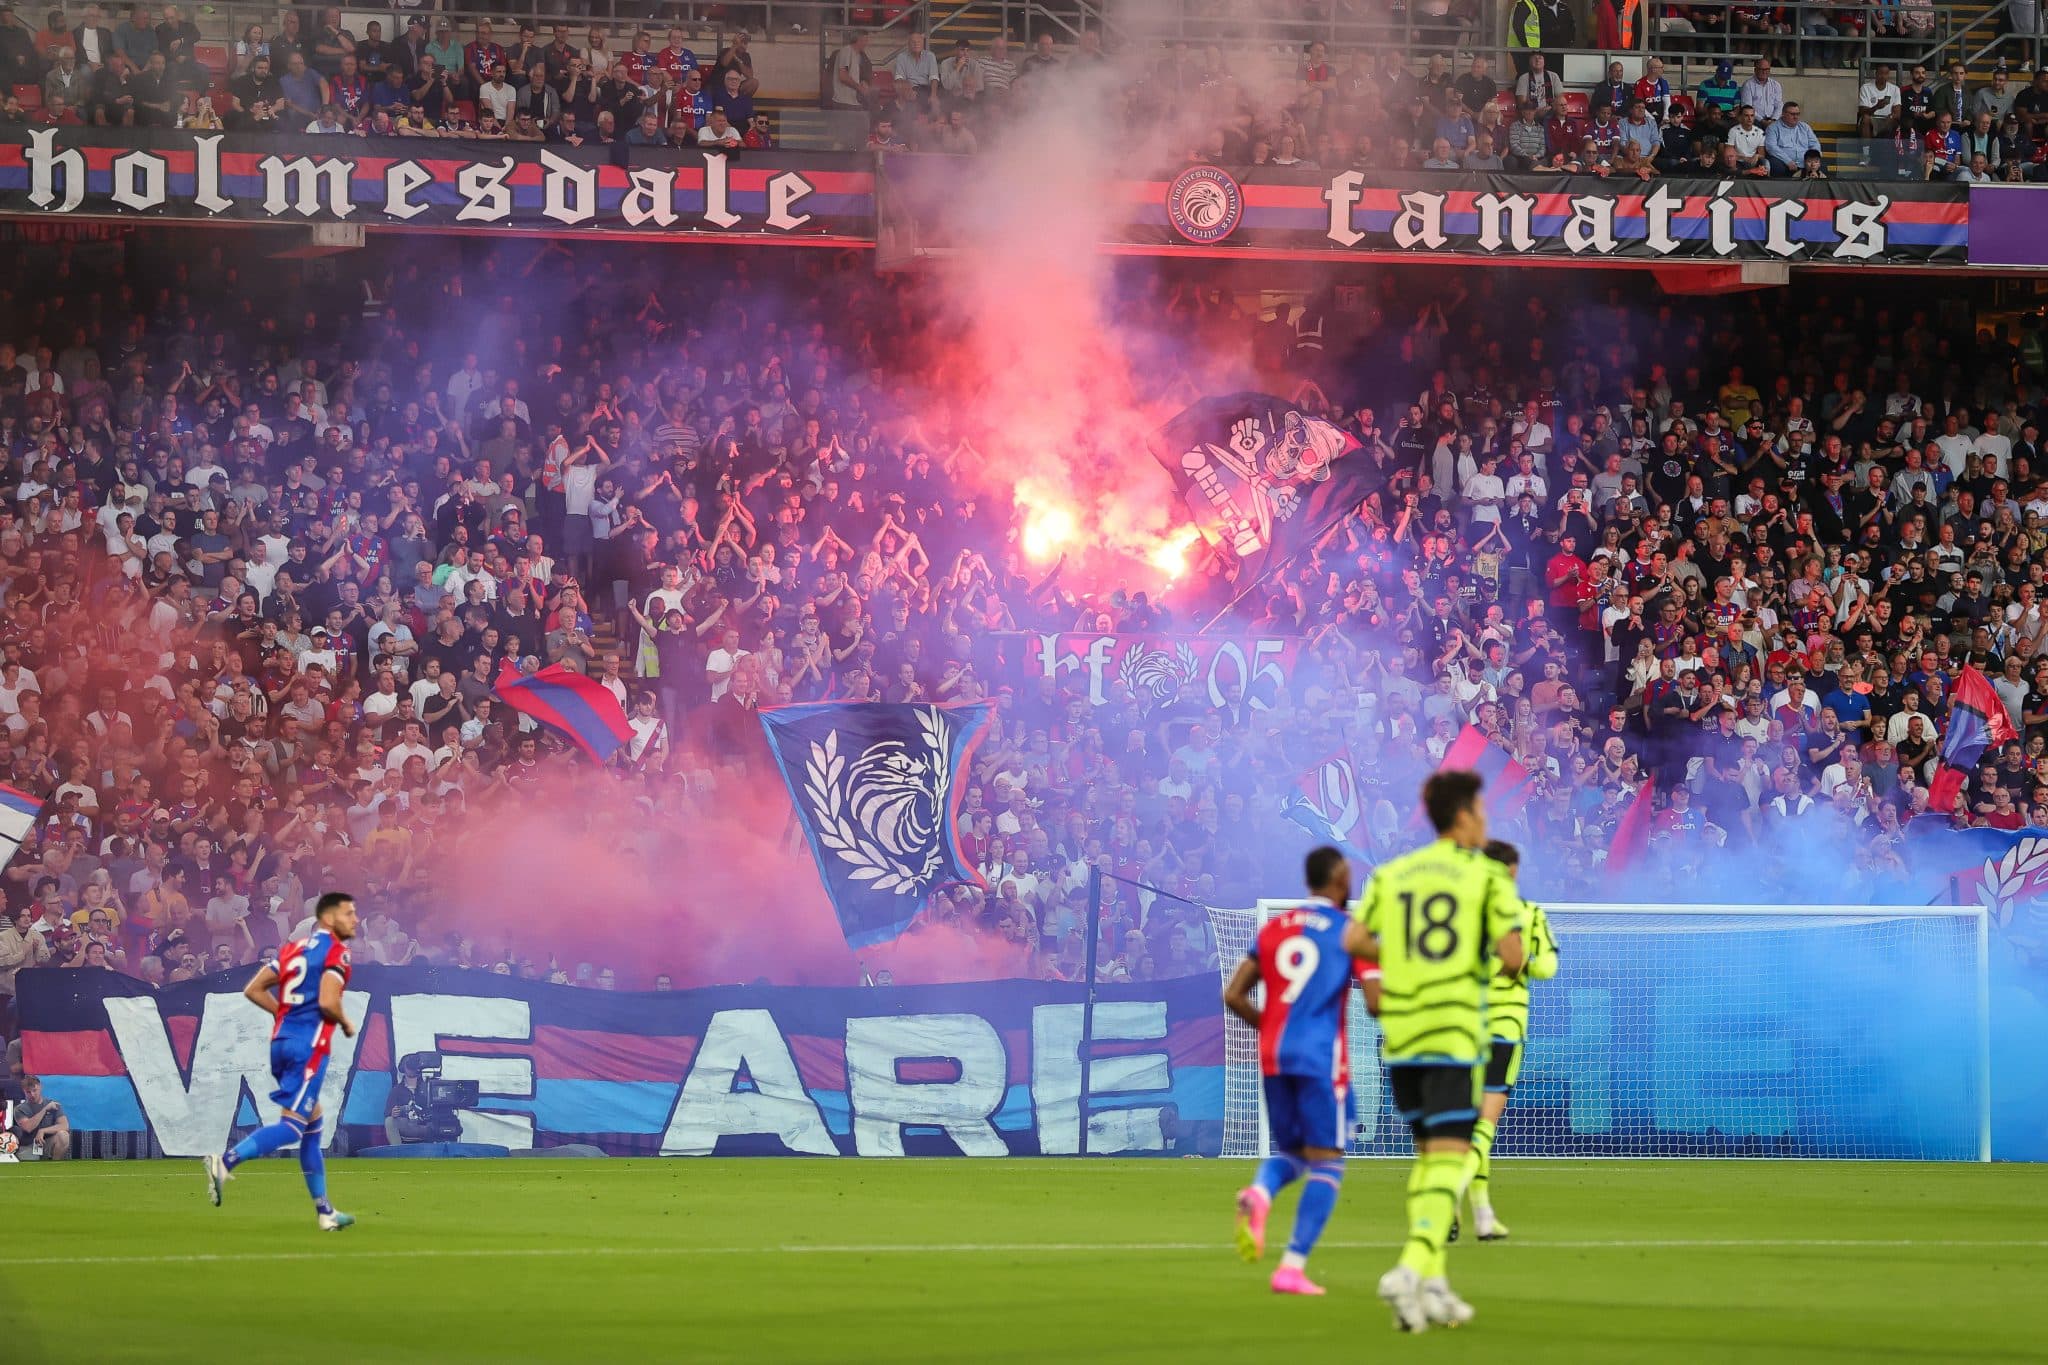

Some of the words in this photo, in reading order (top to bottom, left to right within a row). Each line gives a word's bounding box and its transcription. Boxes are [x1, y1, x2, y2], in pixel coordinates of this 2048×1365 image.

[683, 105, 705, 115] cinch
[25, 128, 815, 230] holmesdale
[1324, 169, 1888, 259] fanatics
[1672, 822, 1696, 831] cinch
[1397, 891, 1459, 962] 18
[283, 955, 308, 1005] 2
[1275, 935, 1321, 1004] 9
[103, 991, 533, 1157] WE
[659, 1001, 1172, 1157] ARE
